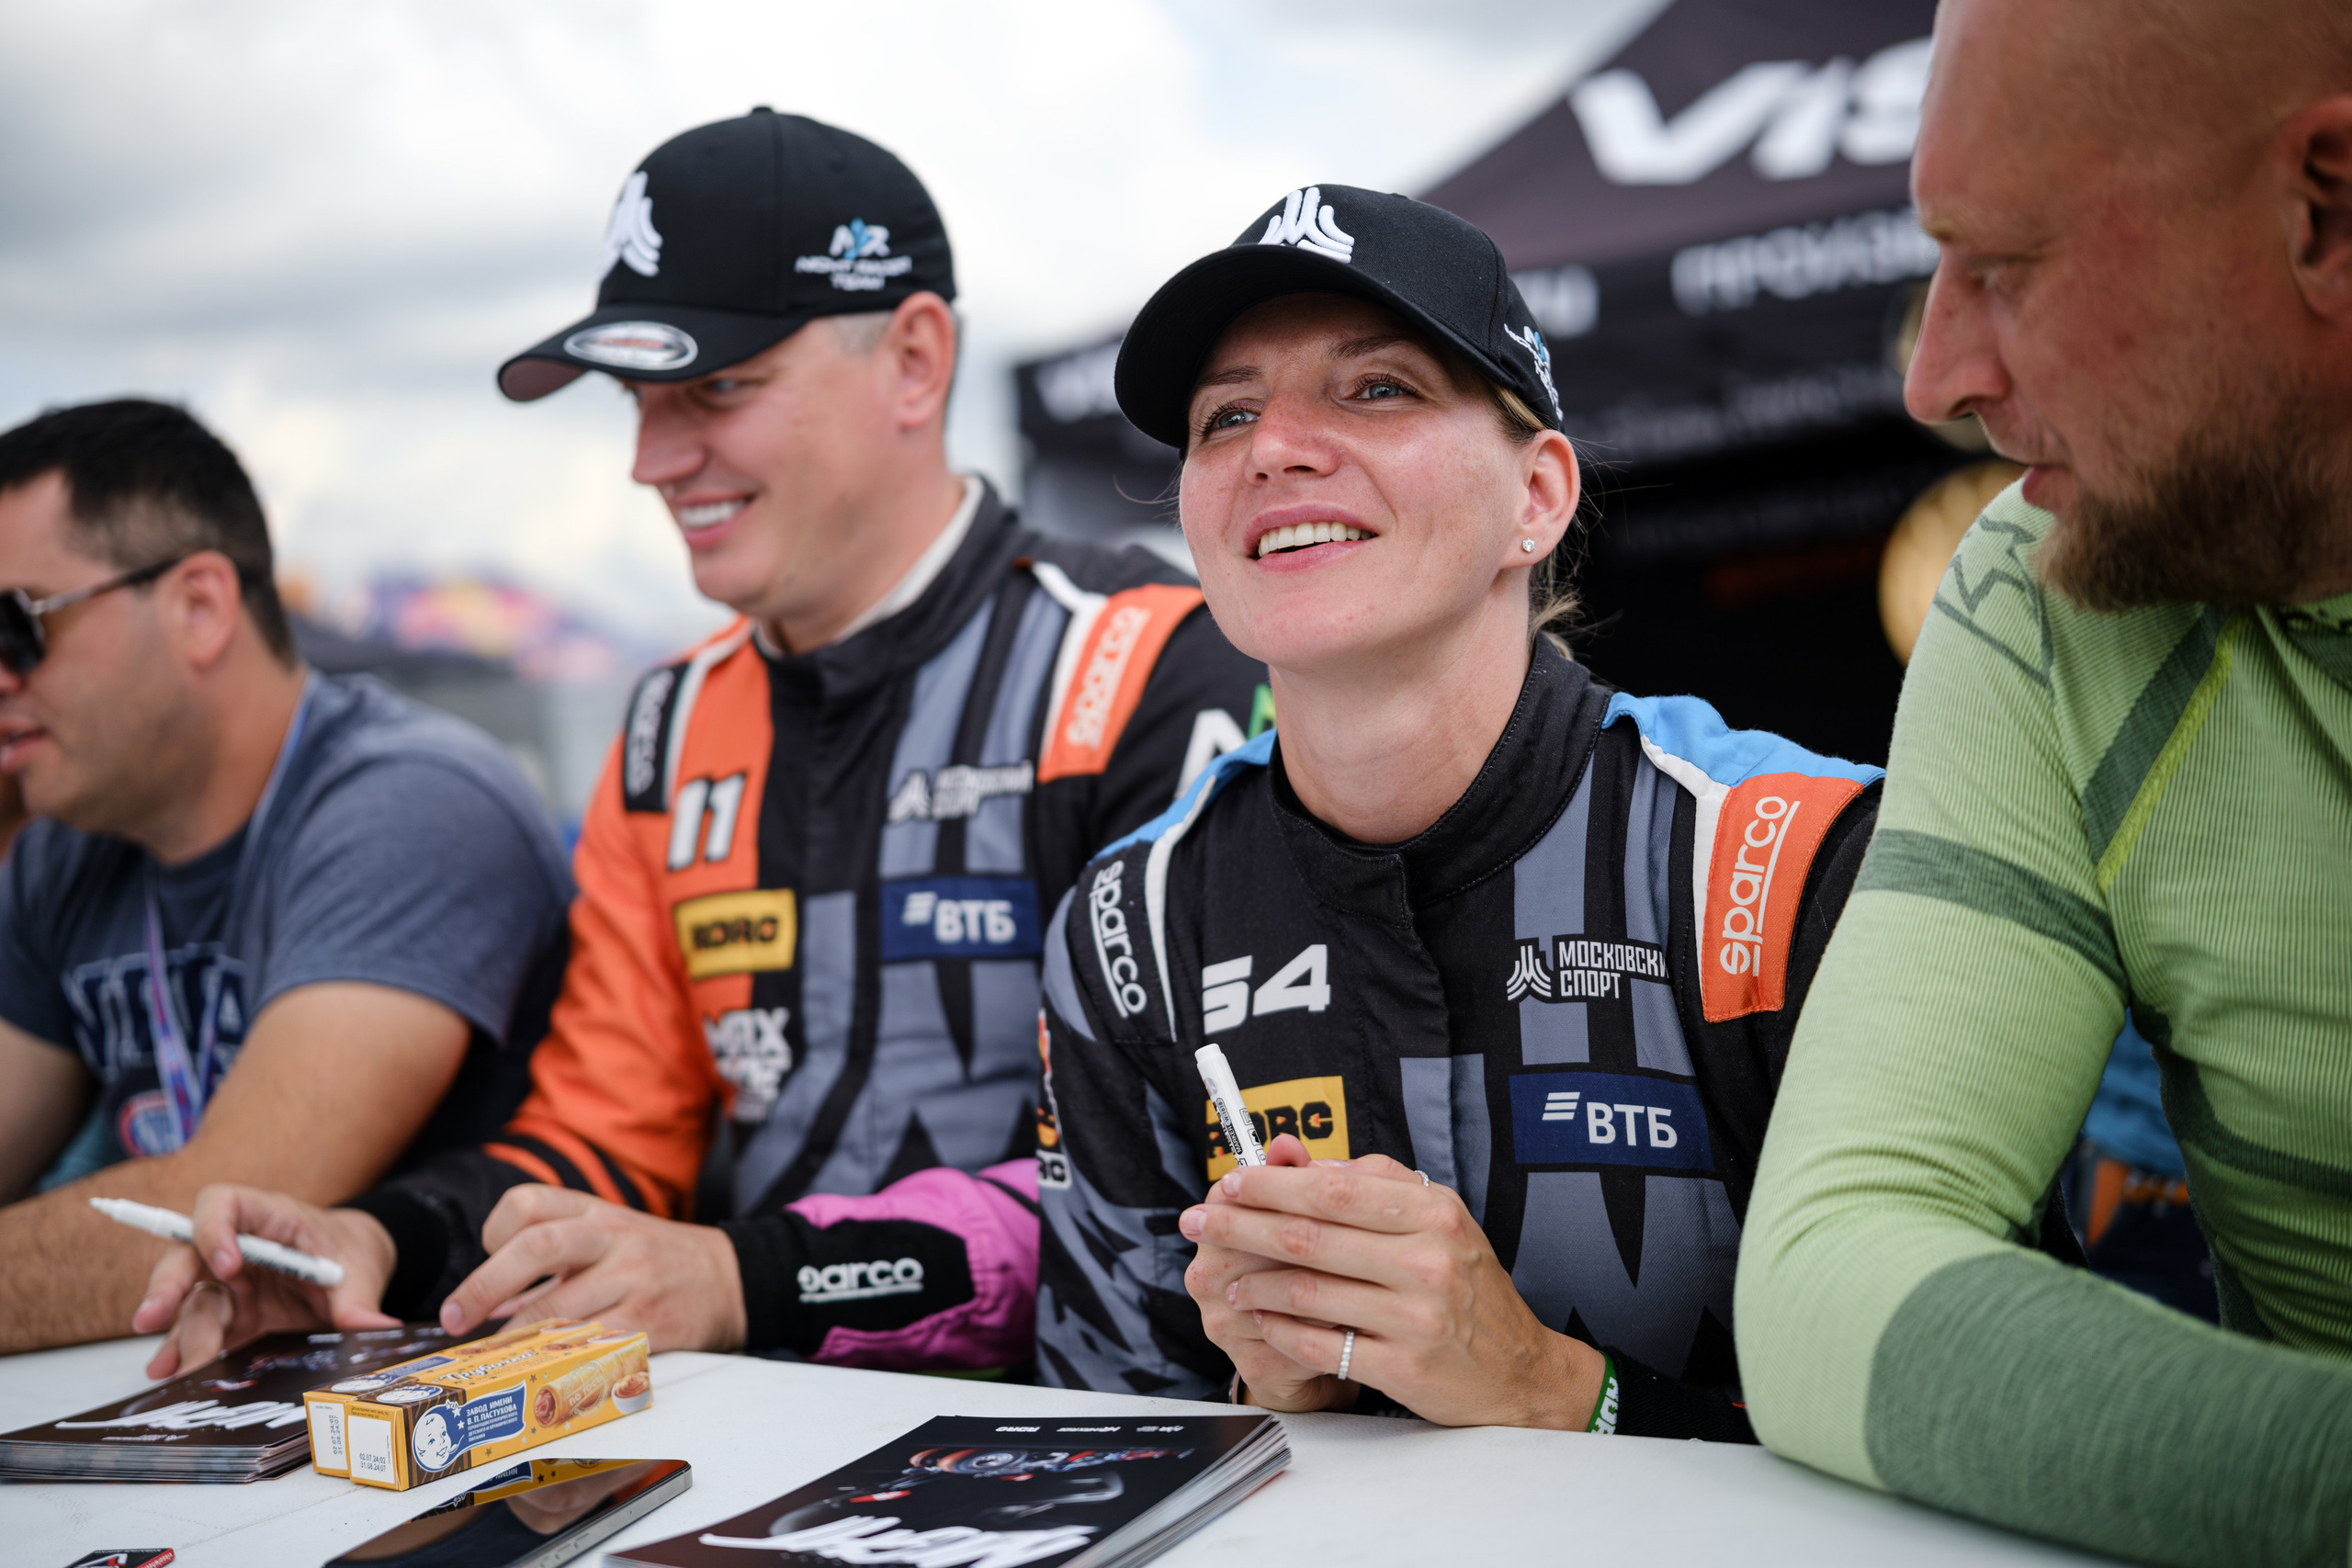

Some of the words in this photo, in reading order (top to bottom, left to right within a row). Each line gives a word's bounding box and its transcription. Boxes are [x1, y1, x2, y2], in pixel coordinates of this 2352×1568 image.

[1721, 795, 1800, 977] sparco
[935, 900, 1016, 944] ВТБ
[1089, 860, 1148, 1019] sparco
[1203, 943, 1330, 1035] 54
[1560, 969, 1621, 999] СПОРТ
[1227, 1122, 1243, 1156] MARKER
[1585, 1101, 1678, 1148] ВТБ
[466, 1404, 488, 1416] ЗАВОД
[490, 1396, 513, 1409] ИМЕНИ
[481, 1404, 517, 1422] ПАСТУХОВА
